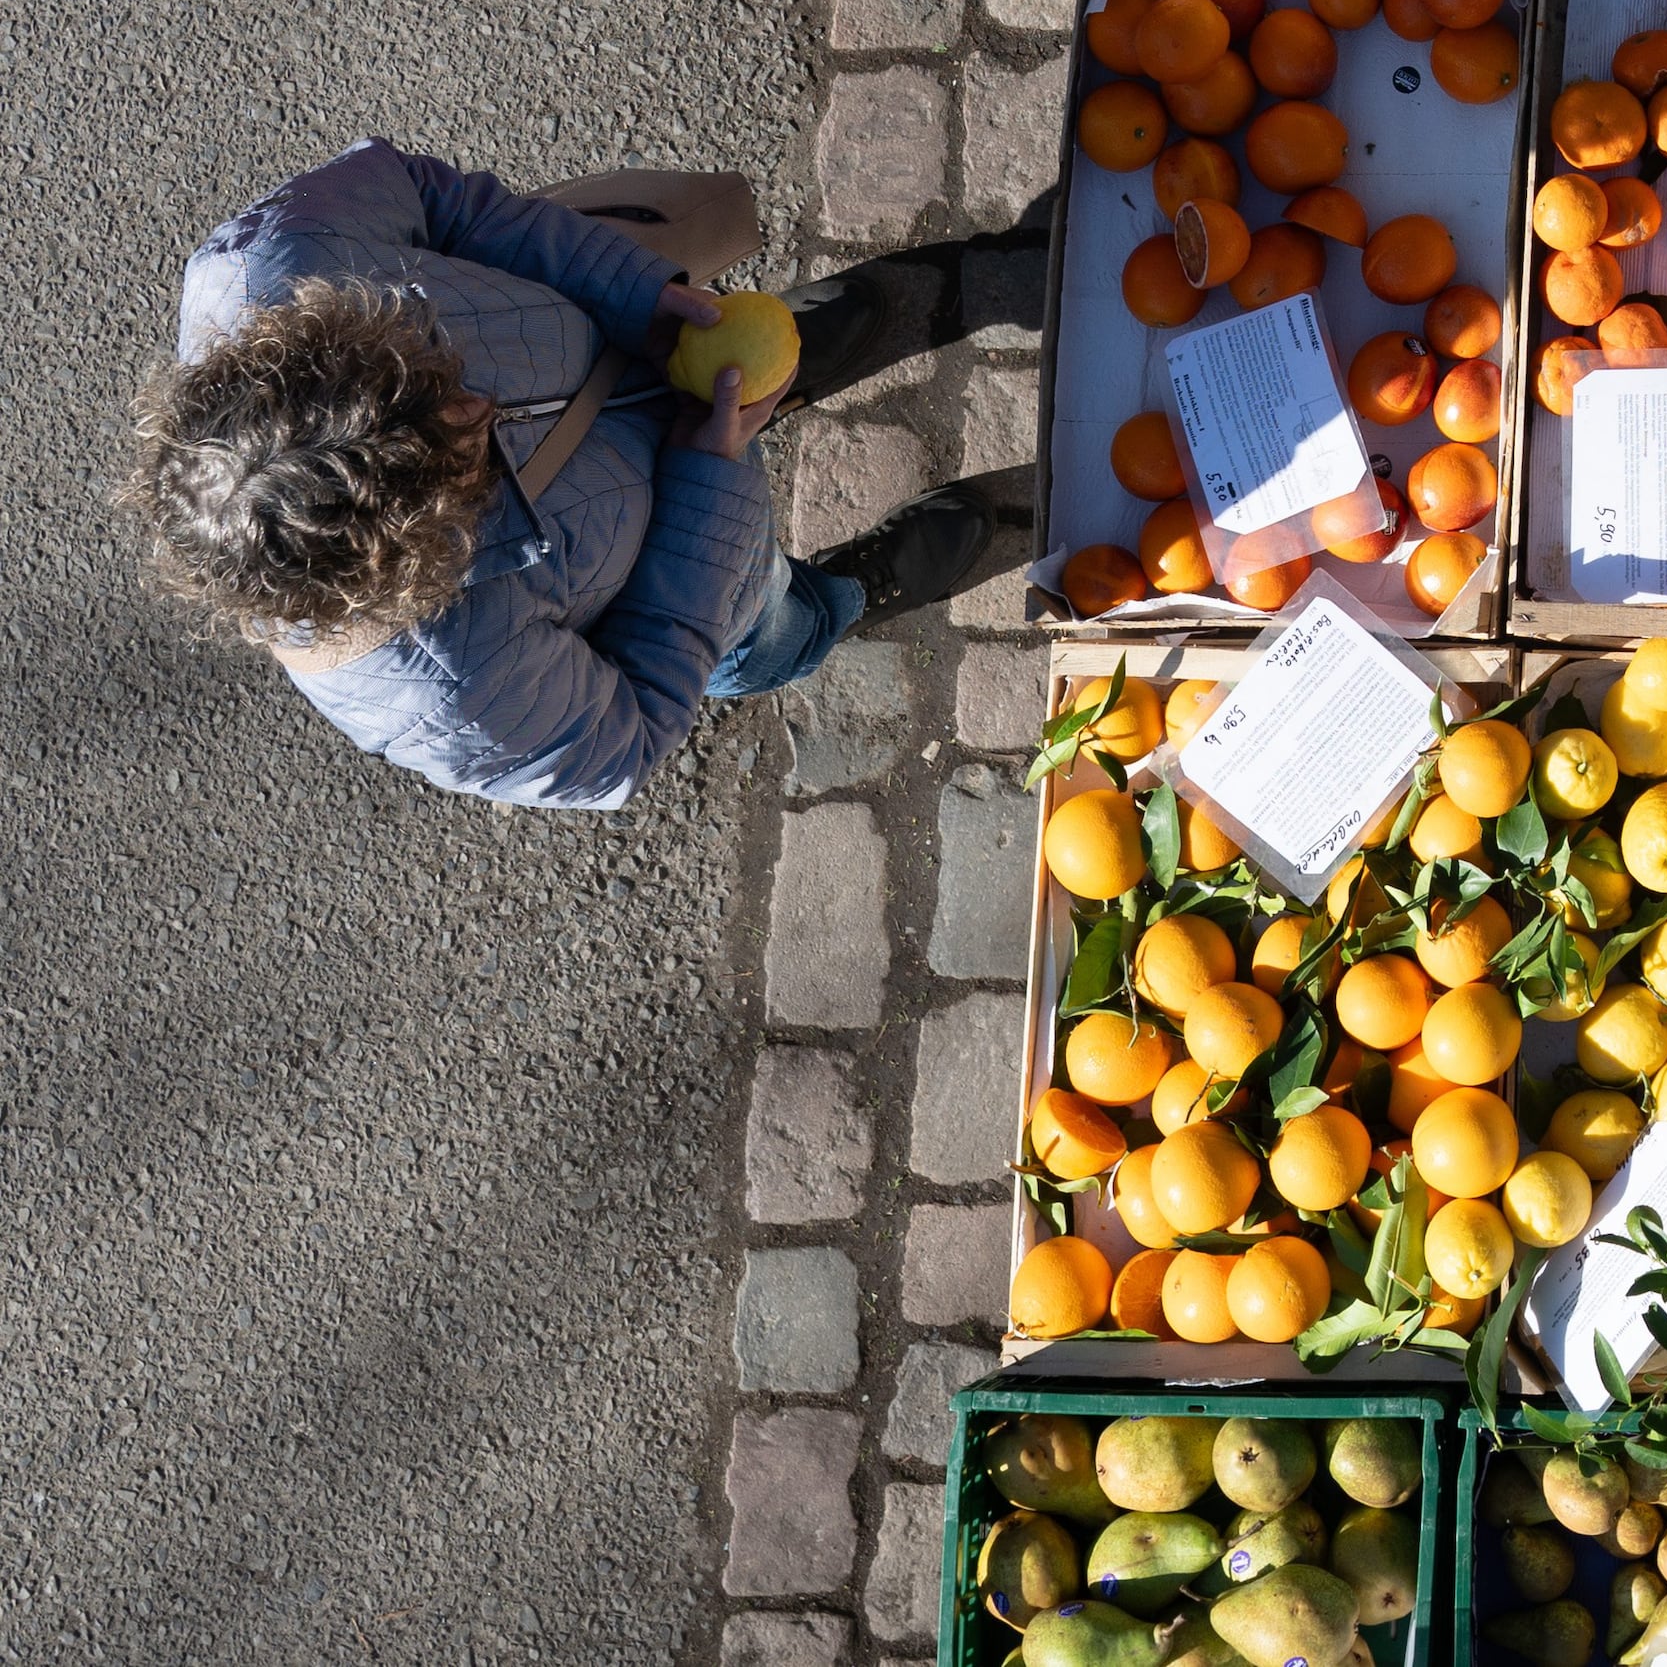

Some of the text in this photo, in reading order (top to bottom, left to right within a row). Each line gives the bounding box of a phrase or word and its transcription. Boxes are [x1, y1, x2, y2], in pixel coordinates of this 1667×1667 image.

[1299, 297, 1321, 352] Blutorange
[1203, 470, 1229, 504] 5,90
[1594, 506, 1616, 542] 5,90
[1217, 703, 1248, 735] 5,90
